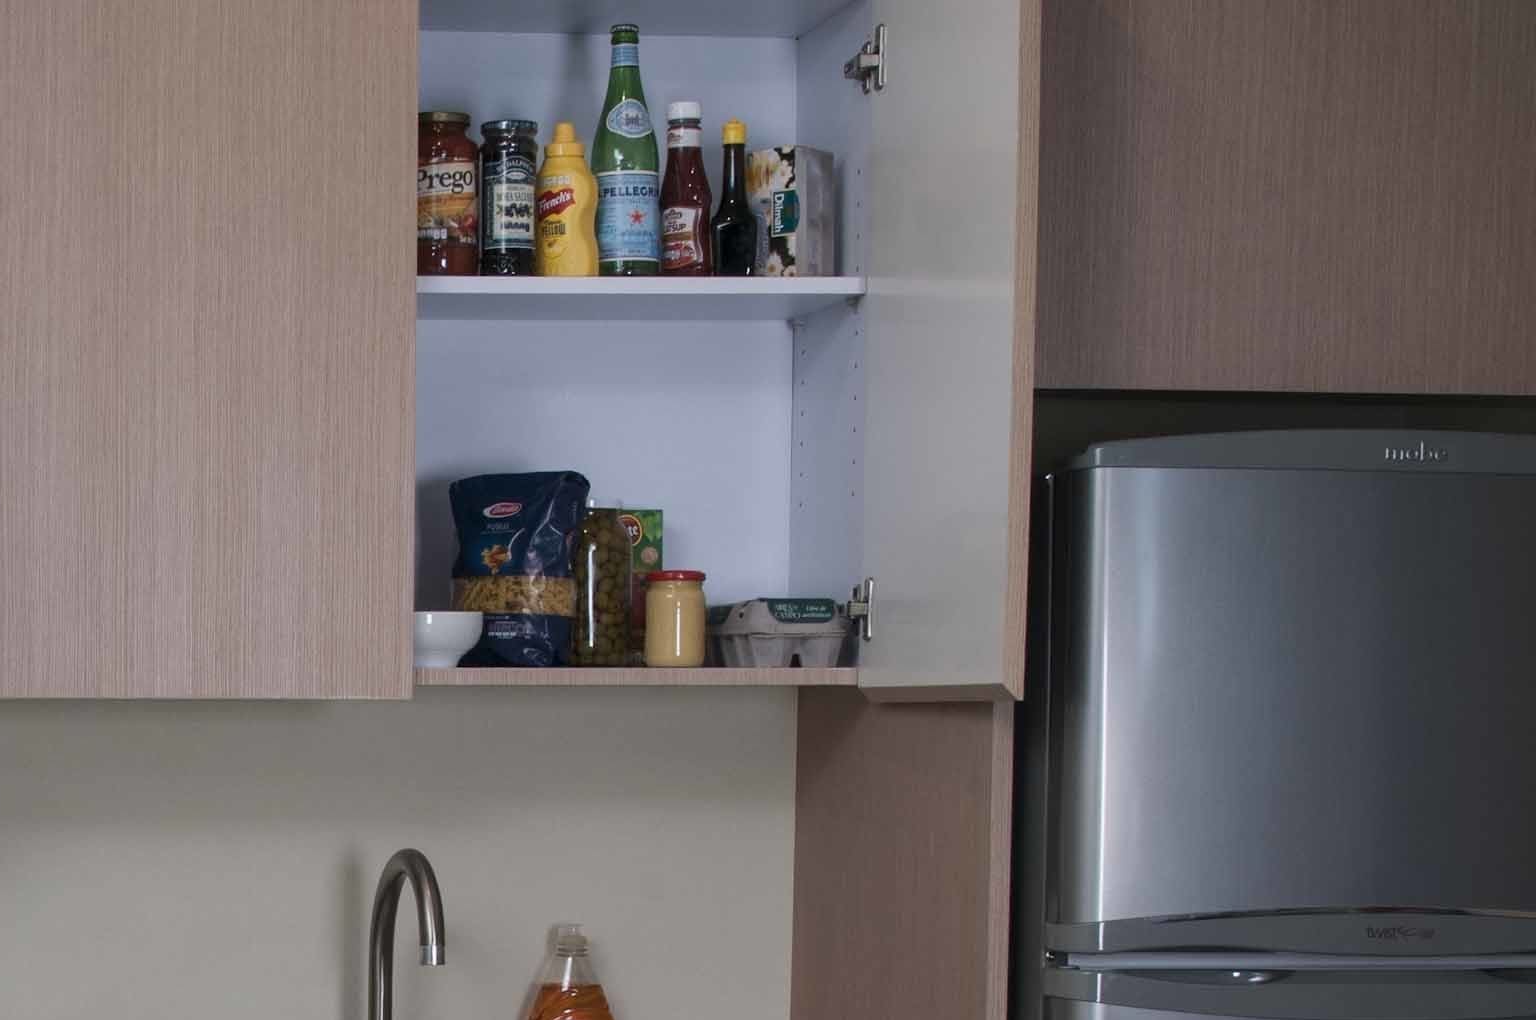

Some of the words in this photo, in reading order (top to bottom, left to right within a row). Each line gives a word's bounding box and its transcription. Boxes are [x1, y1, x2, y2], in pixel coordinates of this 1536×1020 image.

[418, 171, 473, 194] Prego
[538, 191, 571, 215] French's
[774, 193, 784, 233] Dilmah
